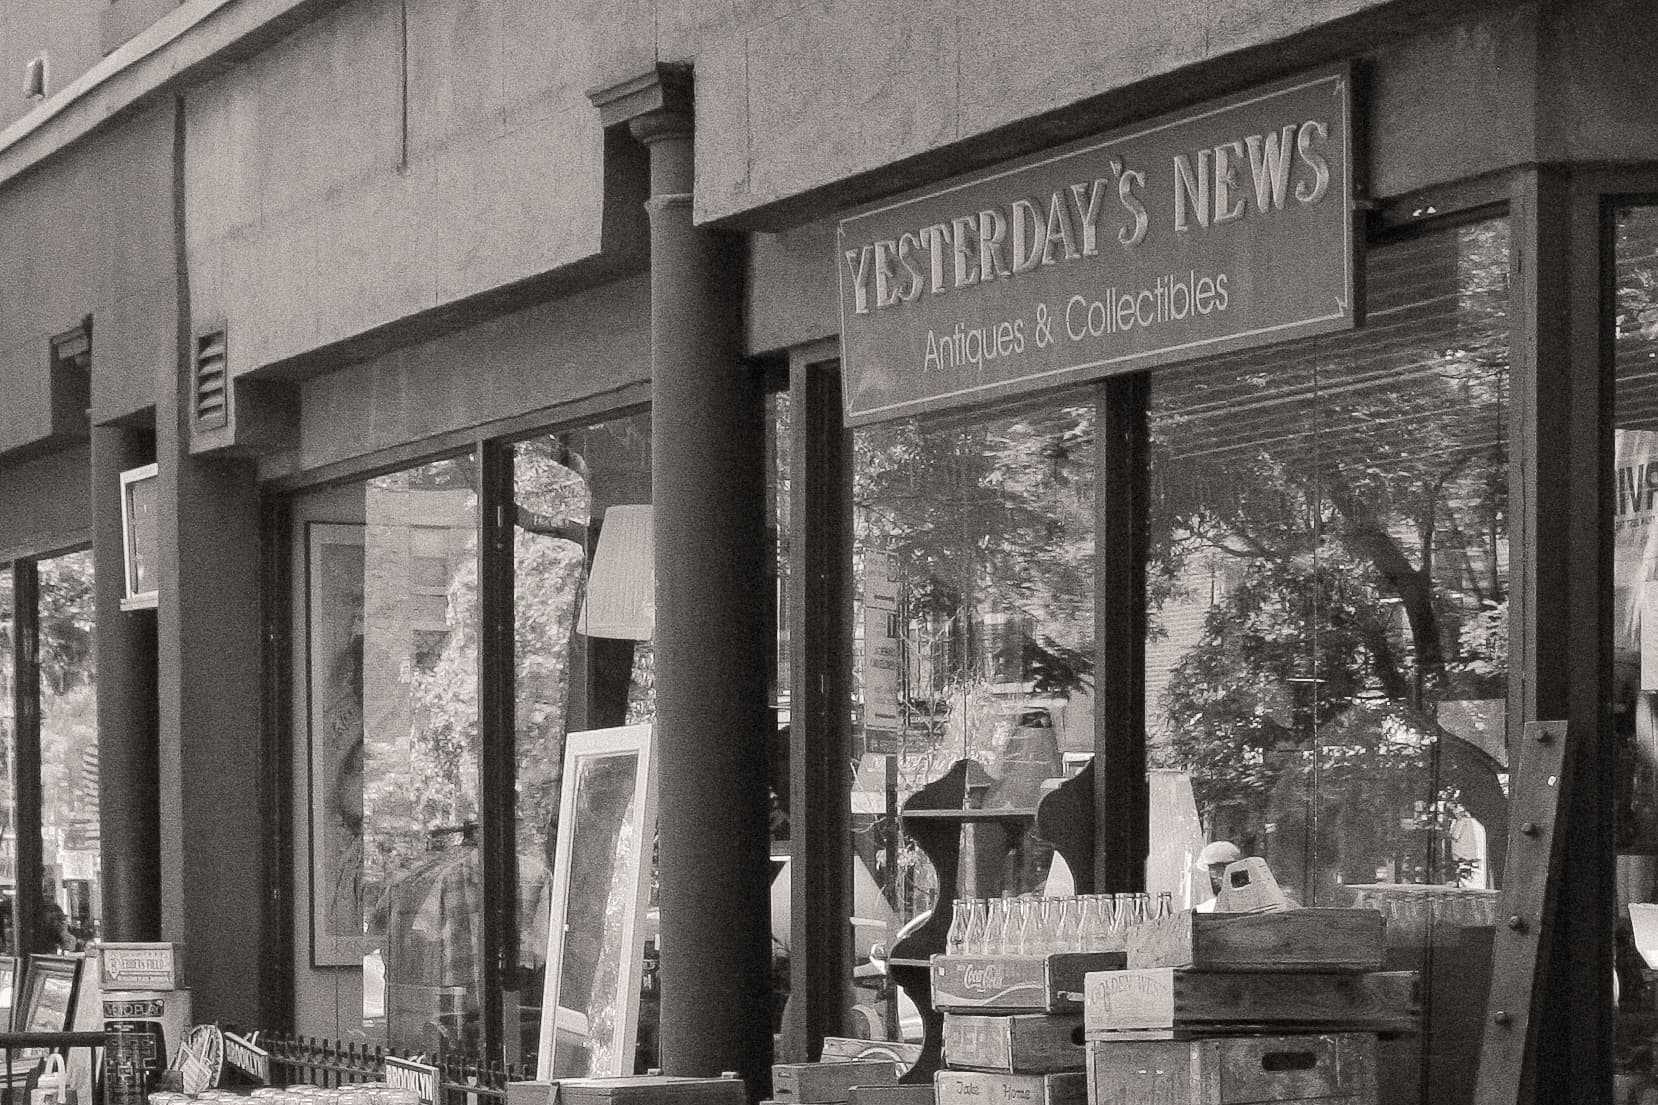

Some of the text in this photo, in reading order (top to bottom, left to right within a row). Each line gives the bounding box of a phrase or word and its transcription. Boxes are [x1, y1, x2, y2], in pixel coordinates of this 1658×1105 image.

[845, 120, 1330, 315] YESTERDAY'S NEWS
[924, 272, 1230, 373] Antiques & Collectibles
[385, 1064, 434, 1101] BROOKLYN
